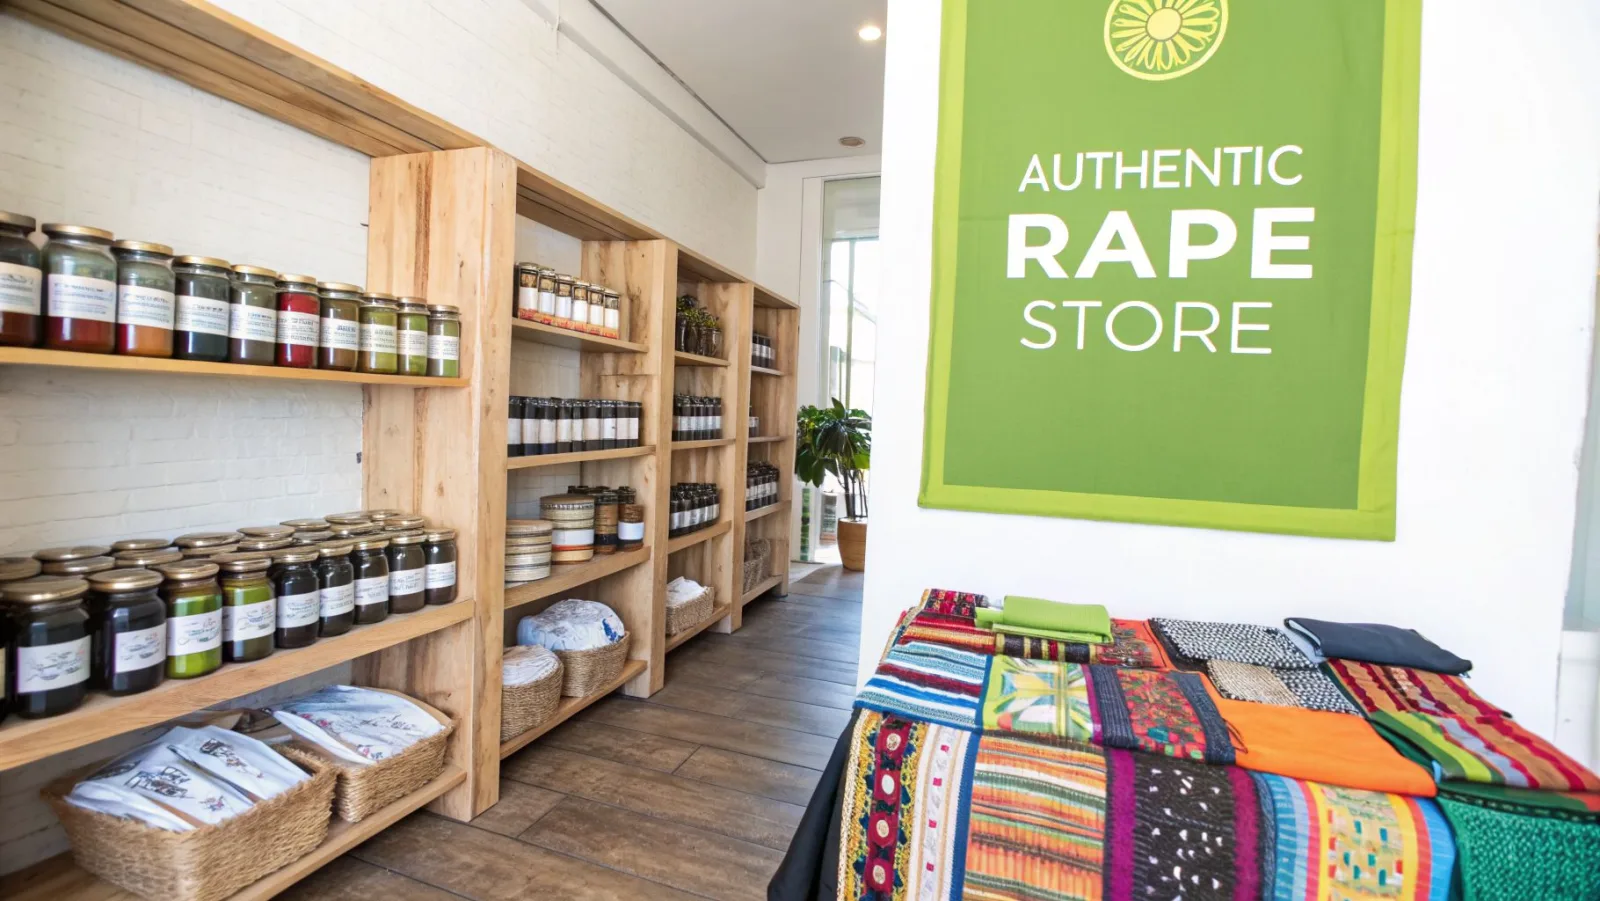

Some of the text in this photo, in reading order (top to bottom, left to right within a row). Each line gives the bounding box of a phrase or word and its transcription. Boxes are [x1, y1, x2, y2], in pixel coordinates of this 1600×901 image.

[1018, 144, 1303, 192] AUTHENTIC
[1006, 207, 1315, 279] RAPE
[1020, 300, 1273, 354] STORE
